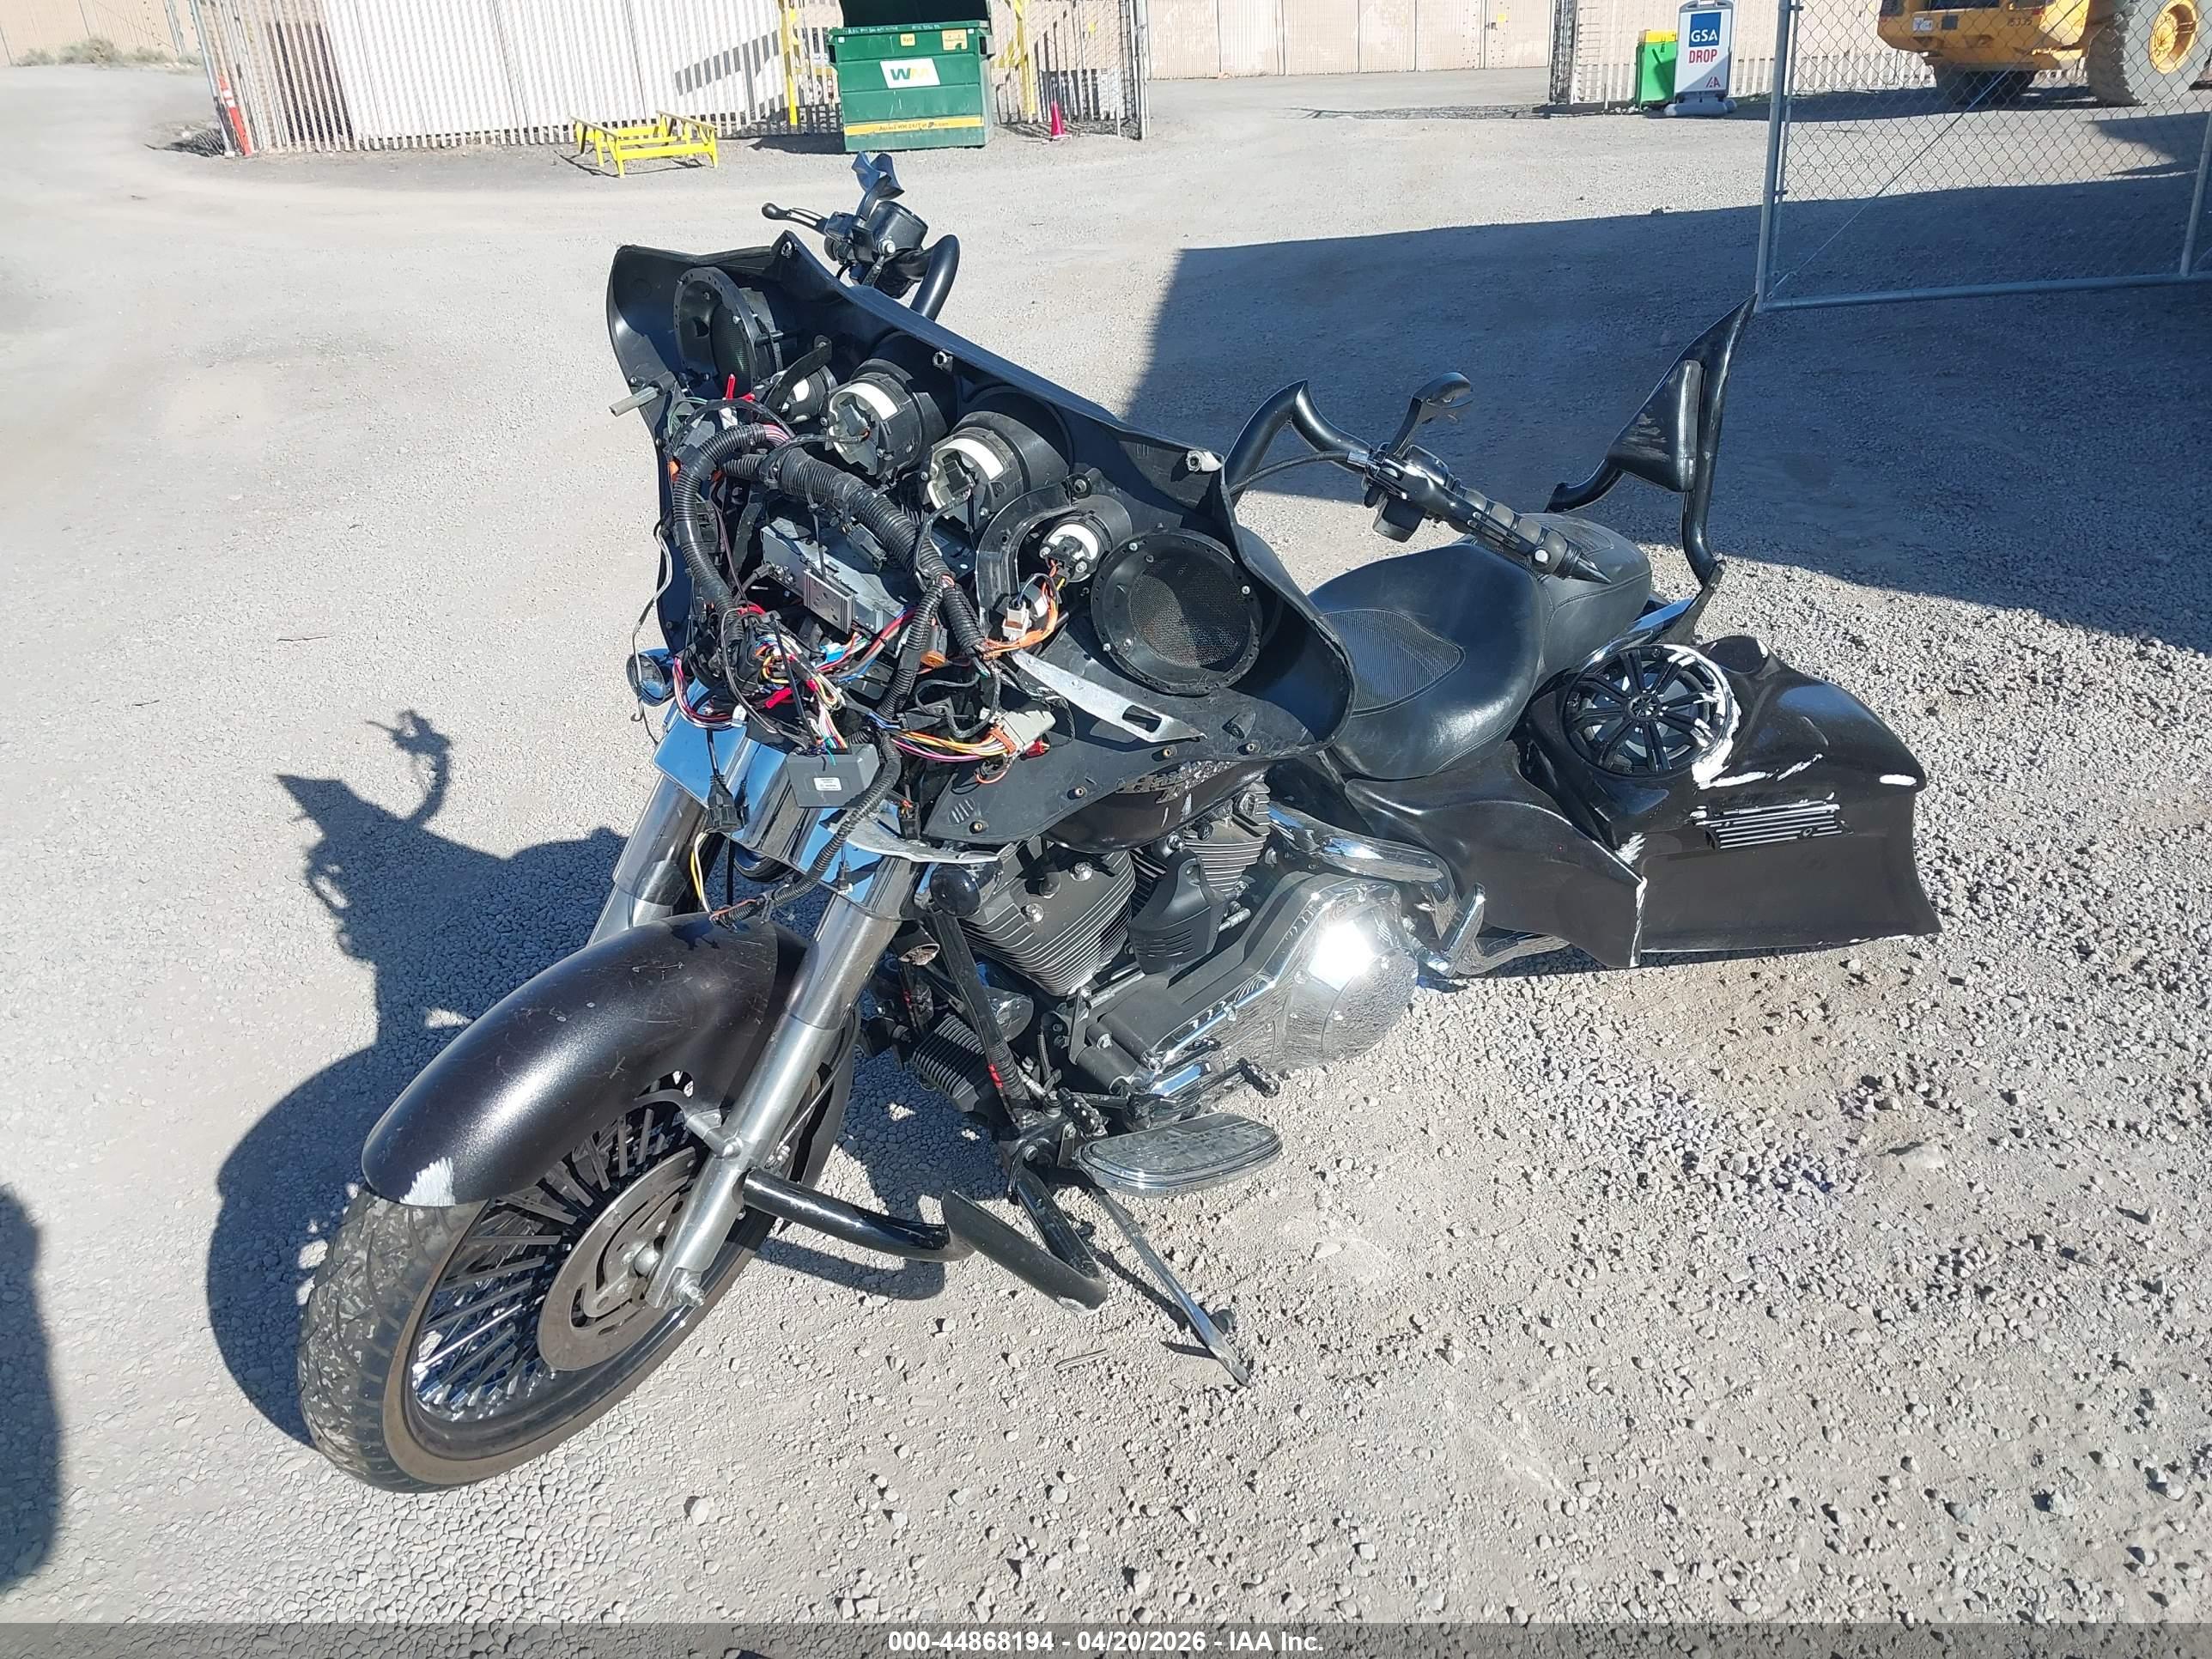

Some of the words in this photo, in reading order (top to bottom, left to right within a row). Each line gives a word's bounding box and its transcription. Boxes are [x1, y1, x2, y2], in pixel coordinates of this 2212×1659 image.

[1691, 28, 1718, 43] GSA
[1689, 49, 1718, 64] DROP
[890, 67, 929, 82] WM
